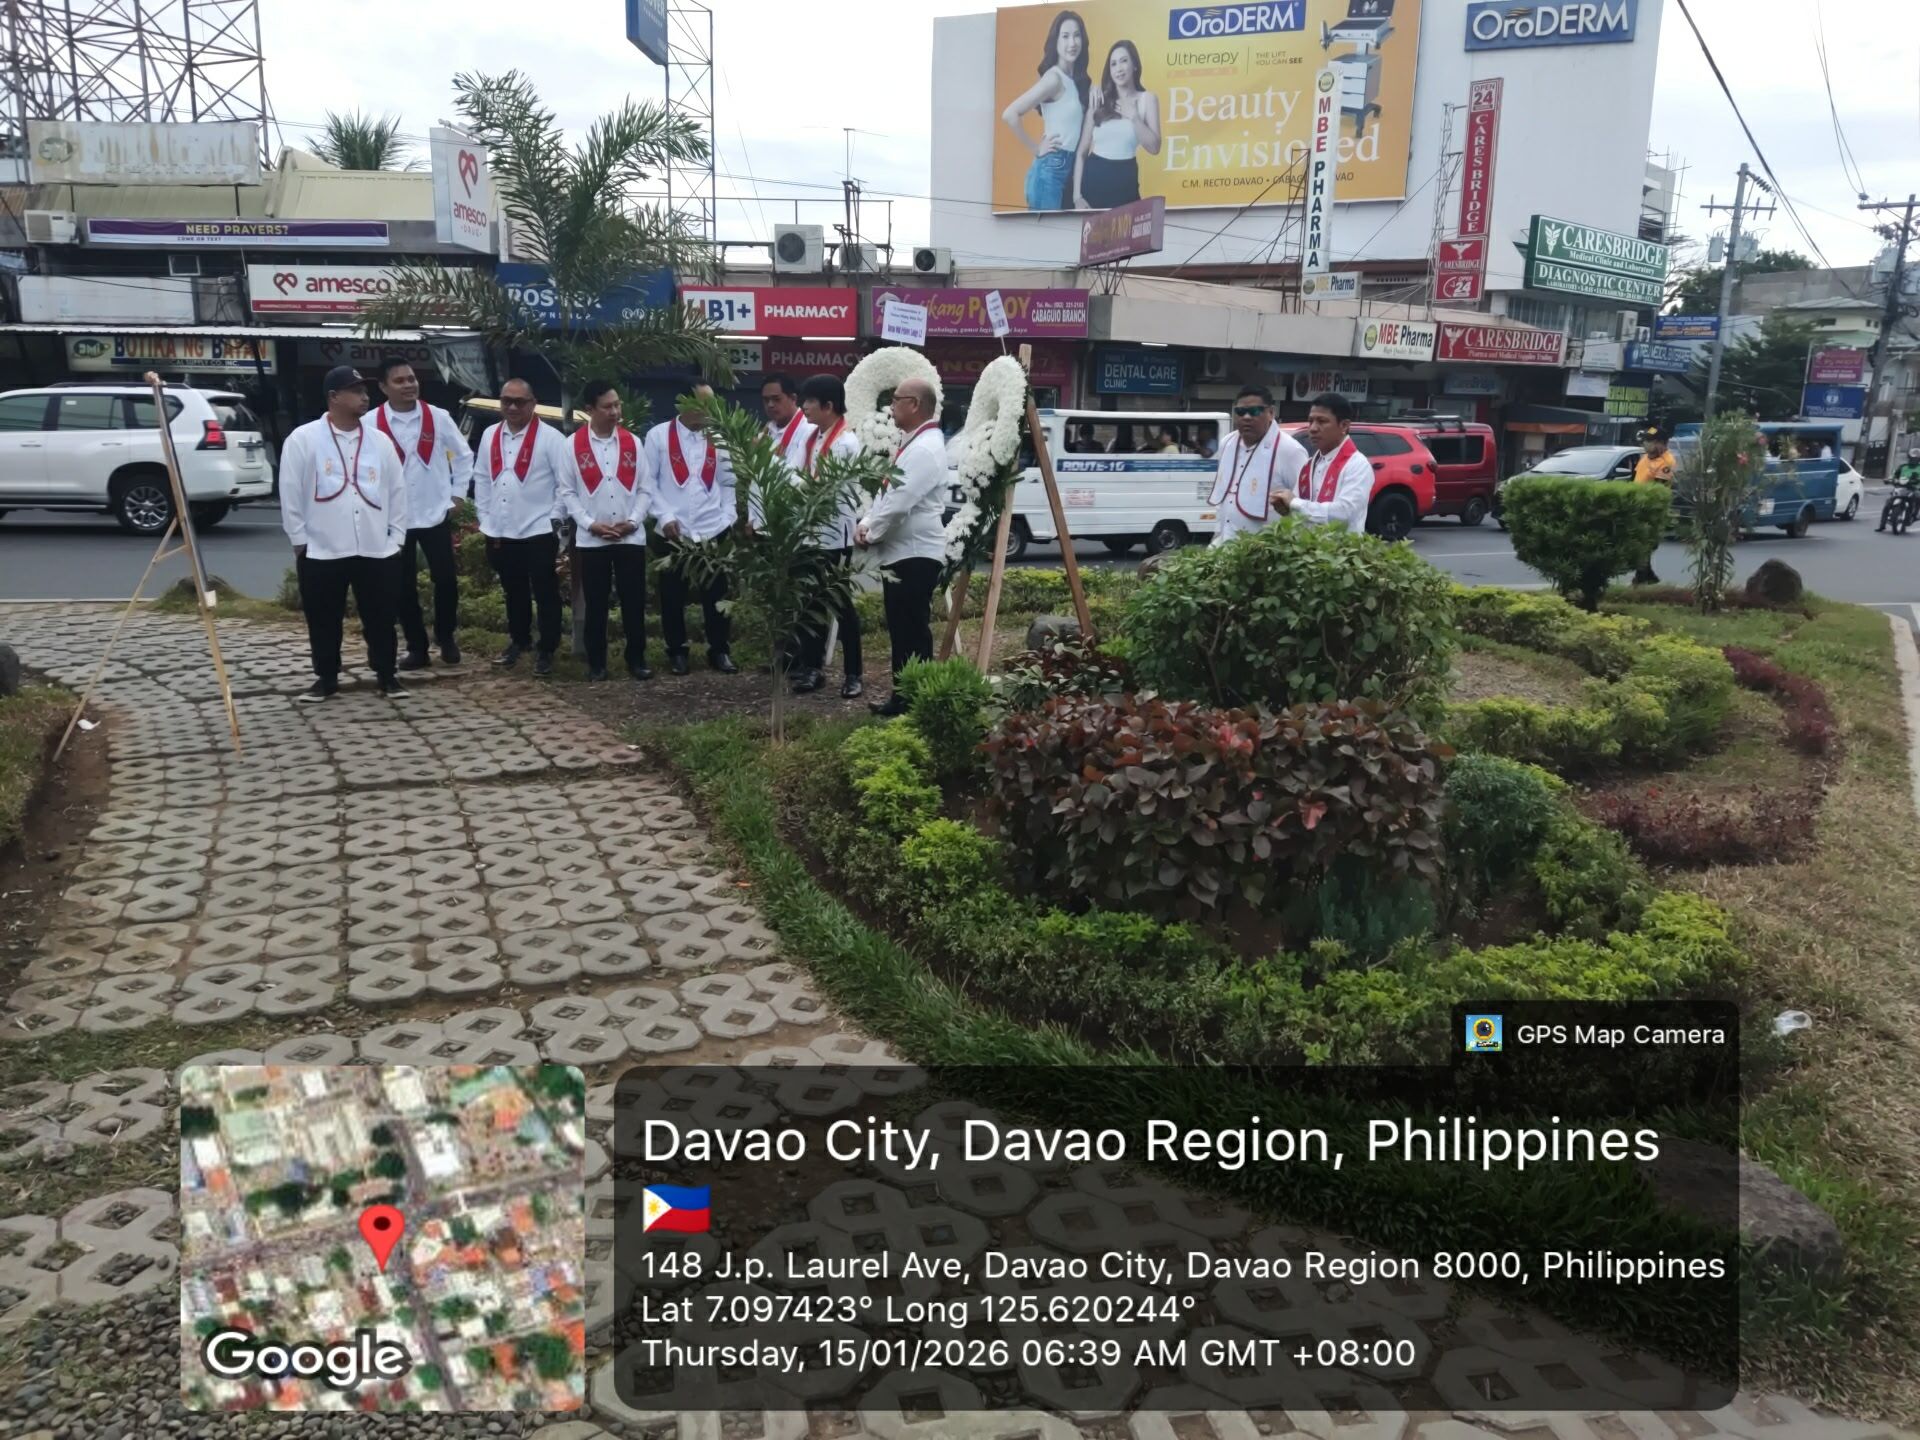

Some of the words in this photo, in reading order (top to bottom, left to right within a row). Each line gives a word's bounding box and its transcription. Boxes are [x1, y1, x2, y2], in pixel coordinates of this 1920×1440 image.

[1179, 3, 1296, 37] OroDERM
[1473, 1, 1629, 40] OroDERM
[1166, 51, 1240, 67] Ultherapy
[1288, 57, 1303, 65] SEE
[1473, 83, 1496, 92] OPEN
[1474, 90, 1493, 105] 24
[1167, 85, 1302, 129] Beauty
[1316, 97, 1332, 153] MBE
[1164, 123, 1380, 171] Envisioed
[1203, 178, 1231, 188] RECTO
[1233, 177, 1264, 187] DAVAO
[1466, 113, 1489, 233] CARESBRIDGE
[454, 202, 487, 228] amesco
[1307, 161, 1326, 268] PHARMA
[186, 225, 220, 235] NEED
[224, 225, 289, 235] PRAYERS?
[1562, 226, 1664, 266] CARESBRIDGE
[1569, 251, 1595, 263] Medical
[1594, 255, 1612, 267] Clinic
[1613, 259, 1624, 269] and
[1624, 261, 1655, 276] Laboratory
[306, 277, 391, 295] amesco
[1331, 276, 1355, 291] Pharma
[1454, 281, 1472, 294] 24
[1539, 265, 1617, 289] DIAGNOSTIC
[1618, 280, 1660, 298] CENTER
[764, 305, 848, 318] PHARMACY
[1032, 309, 1061, 322] CABAGUIO
[1062, 309, 1086, 323] BRANCH
[1379, 323, 1399, 345] MBE
[1400, 325, 1433, 347] Pharma
[1464, 329, 1561, 351] CARESBRIDGE
[114, 336, 177, 357] BOTIKA
[183, 338, 204, 358] NG
[351, 347, 430, 362] amesco
[1105, 364, 1146, 379] DENTAL
[1149, 366, 1177, 380] CARE
[1311, 372, 1332, 393] MBE
[1334, 373, 1366, 393] Pharma
[1104, 379, 1127, 389] CLINIC
